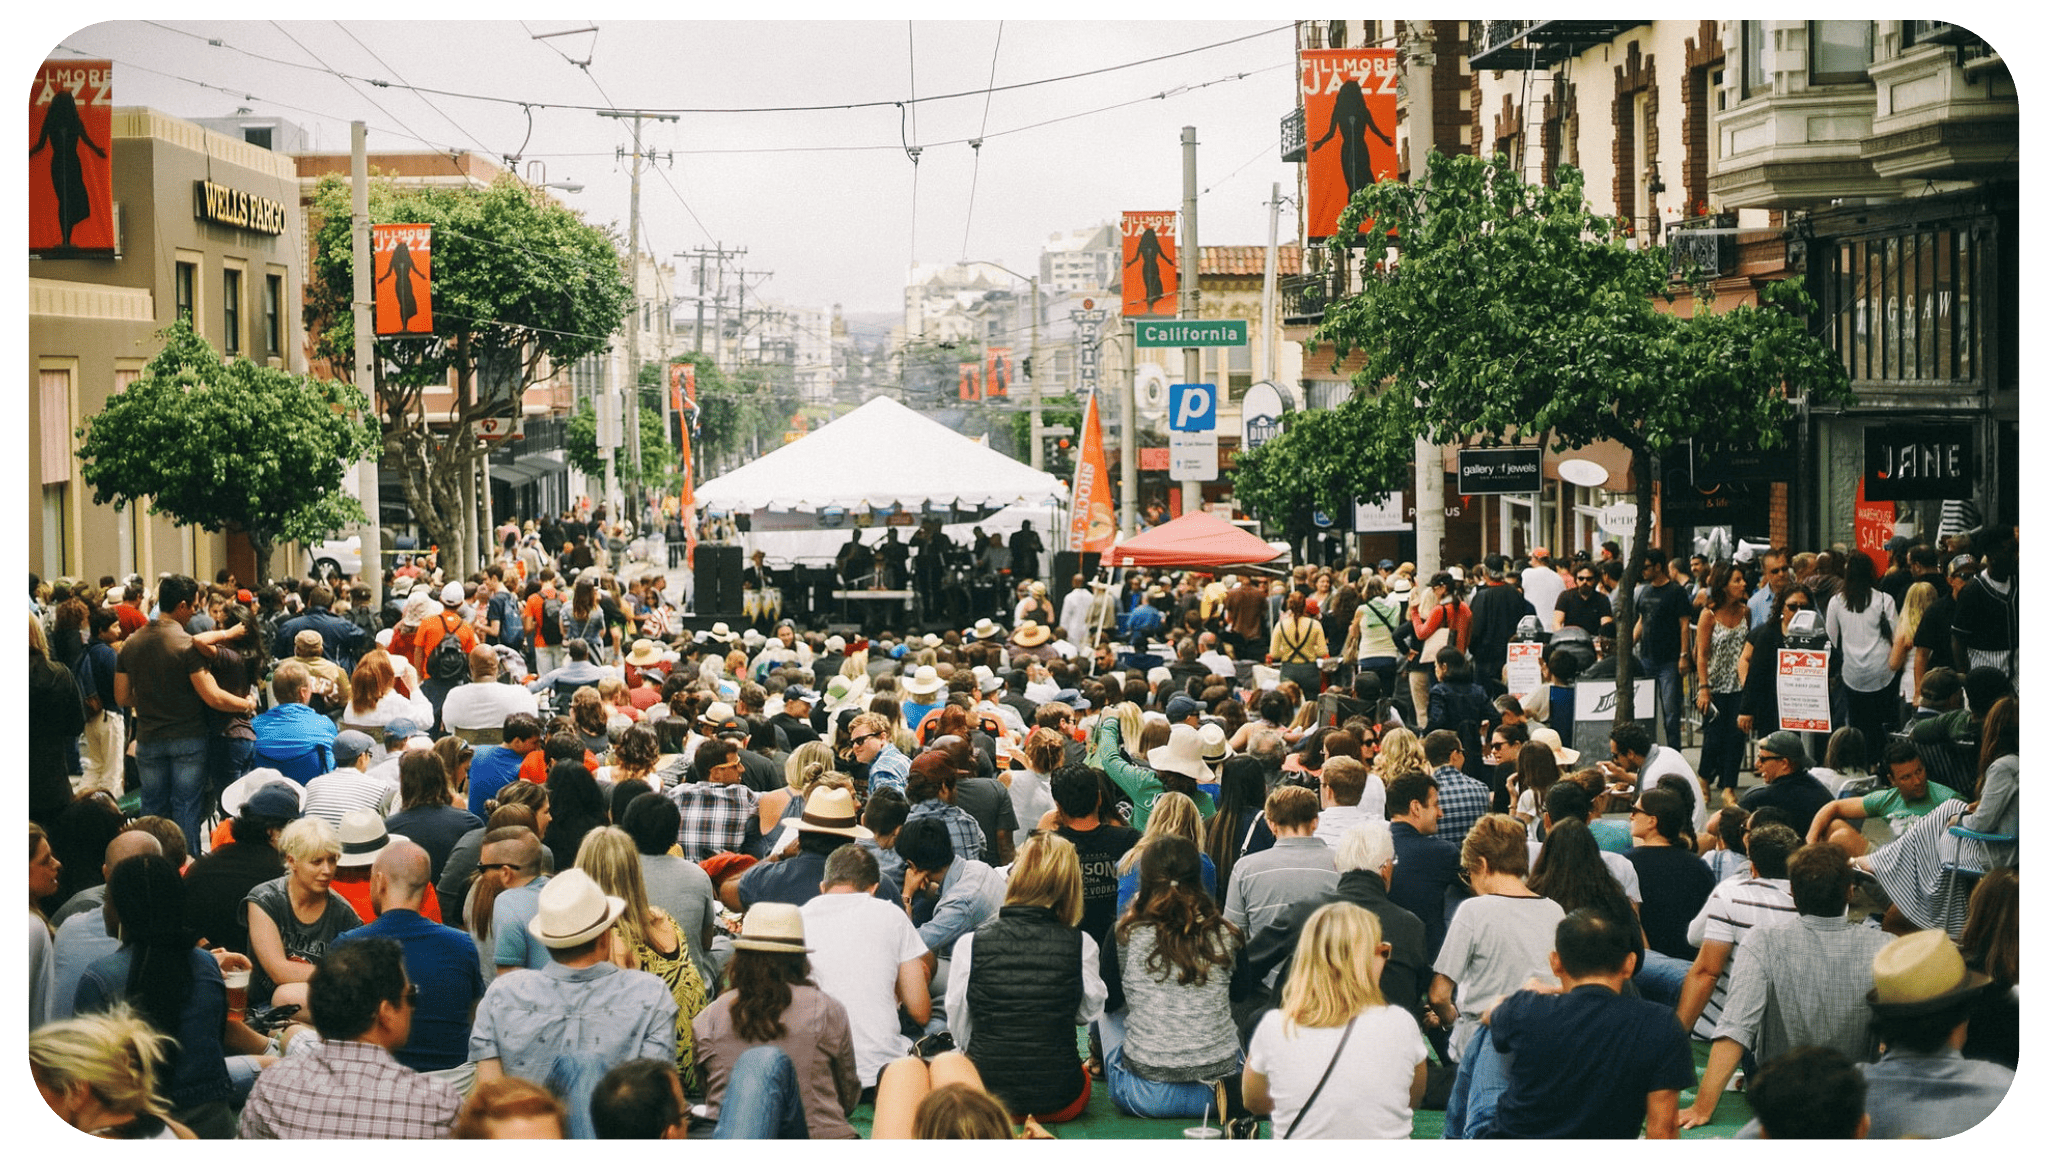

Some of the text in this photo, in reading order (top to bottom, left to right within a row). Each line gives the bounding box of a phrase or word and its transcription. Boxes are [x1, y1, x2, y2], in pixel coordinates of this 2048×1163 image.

[1301, 58, 1396, 72] FILLMORE
[1304, 71, 1396, 95] JAZZ
[35, 81, 111, 105] AZZ
[205, 181, 286, 235] WELLS FARGO
[1122, 215, 1177, 225] FILLMORE
[373, 229, 431, 240] FILLMORE
[1123, 223, 1177, 237] JAZZ
[374, 238, 431, 252] JAZZ
[1857, 291, 1952, 333] JIGSAW
[1145, 327, 1238, 341] California
[1463, 463, 1537, 476] gallery of jewels
[1878, 444, 1961, 480] JANE
[1075, 462, 1095, 522] SHOCK
[1857, 507, 1892, 523] WAREHOUSE
[1862, 527, 1888, 551] SALE
